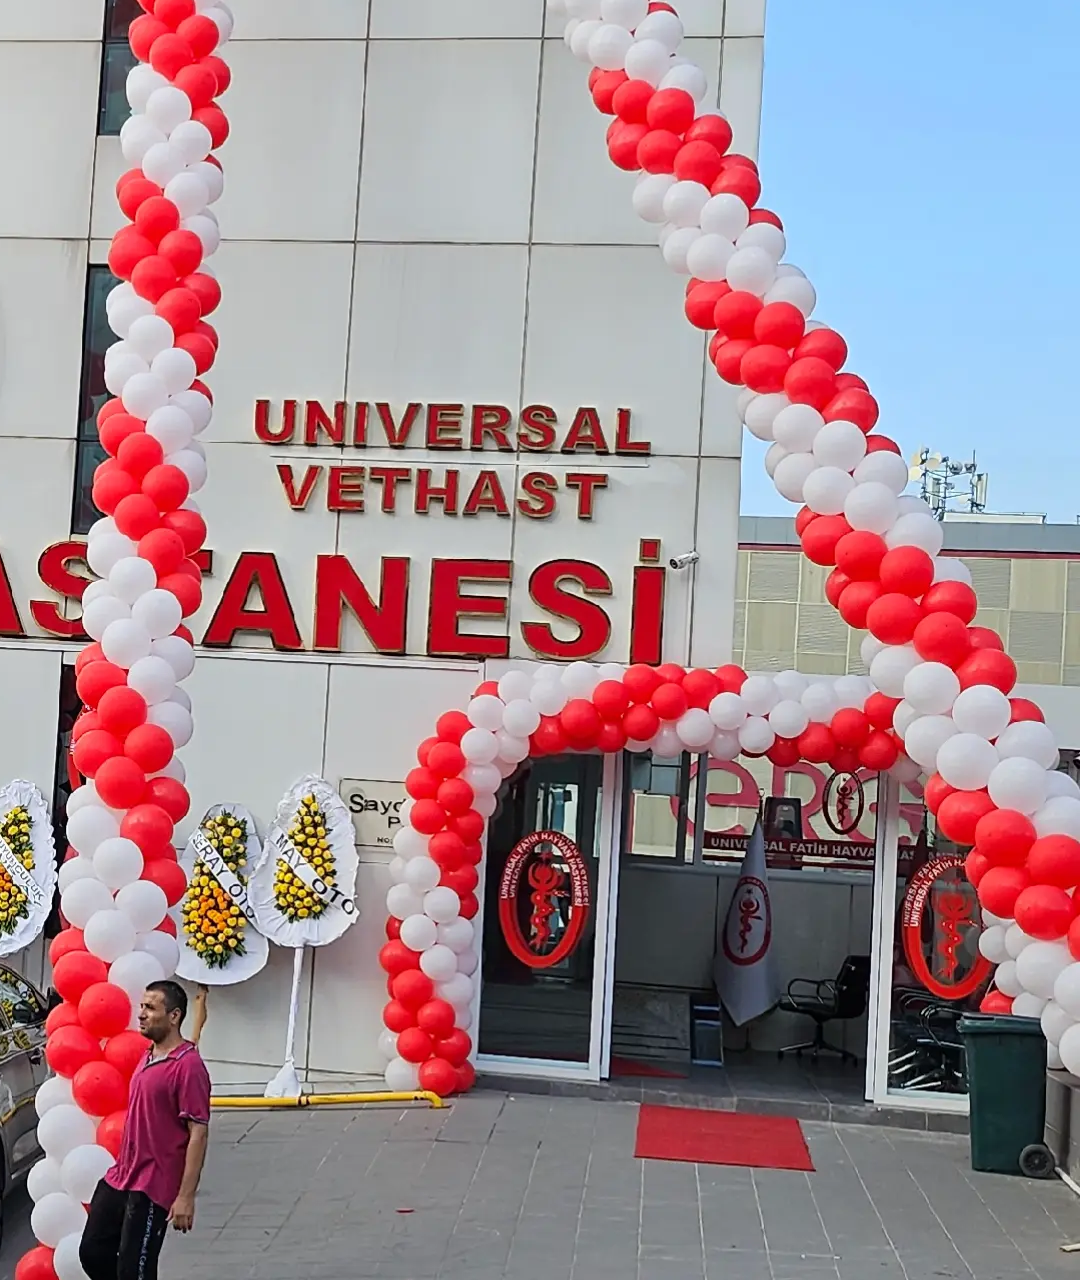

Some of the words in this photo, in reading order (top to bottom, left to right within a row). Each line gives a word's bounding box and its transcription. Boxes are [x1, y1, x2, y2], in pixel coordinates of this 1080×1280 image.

[254, 397, 653, 455] UNIVERSAL
[277, 462, 609, 520] VETHAST
[192, 833, 229, 878] SERAY
[275, 833, 308, 870] MAY
[311, 877, 356, 916] OTO
[710, 837, 787, 853] UNIVESAL
[789, 841, 828, 855] FATİH
[832, 845, 875, 858] HAYVA
